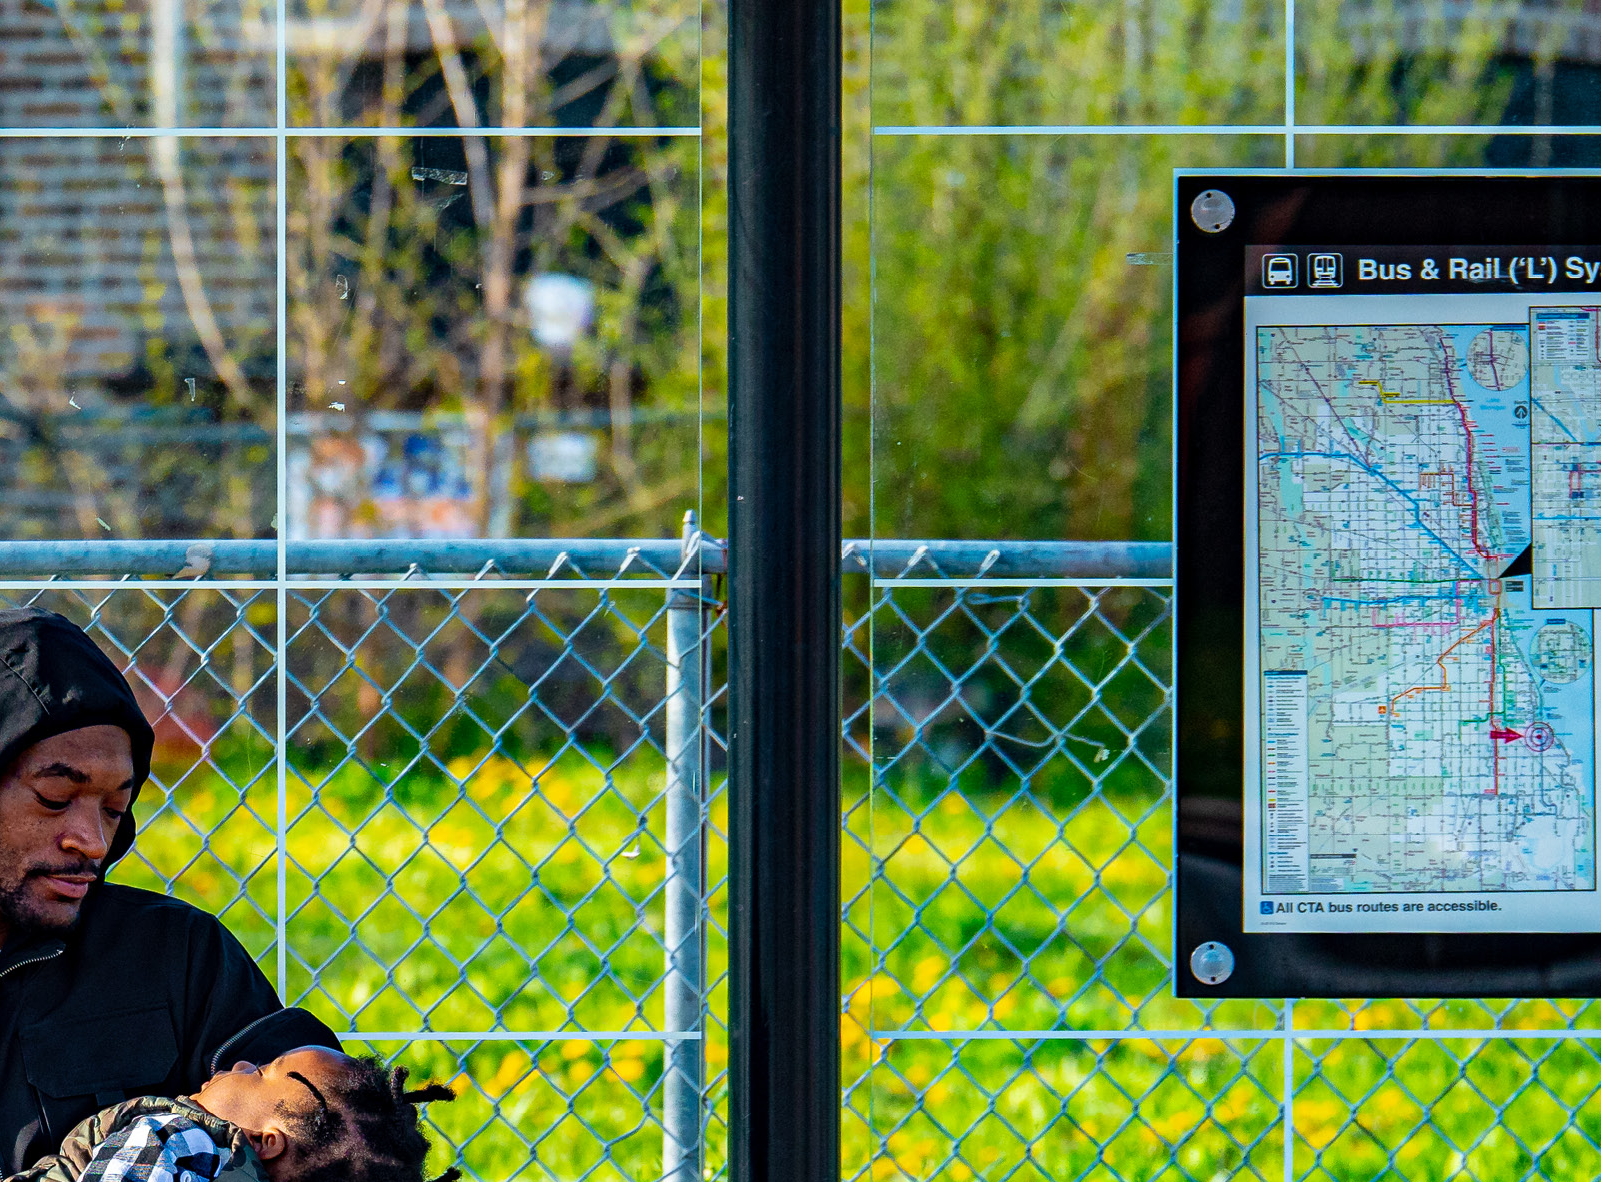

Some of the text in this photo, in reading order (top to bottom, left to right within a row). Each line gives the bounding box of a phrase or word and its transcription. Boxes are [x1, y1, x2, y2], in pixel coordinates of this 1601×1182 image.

[1358, 259, 1412, 281] Bus
[1420, 260, 1440, 280] &
[1449, 258, 1500, 280] Rail
[1276, 900, 1503, 914] All CTA bus routes are accessible.
